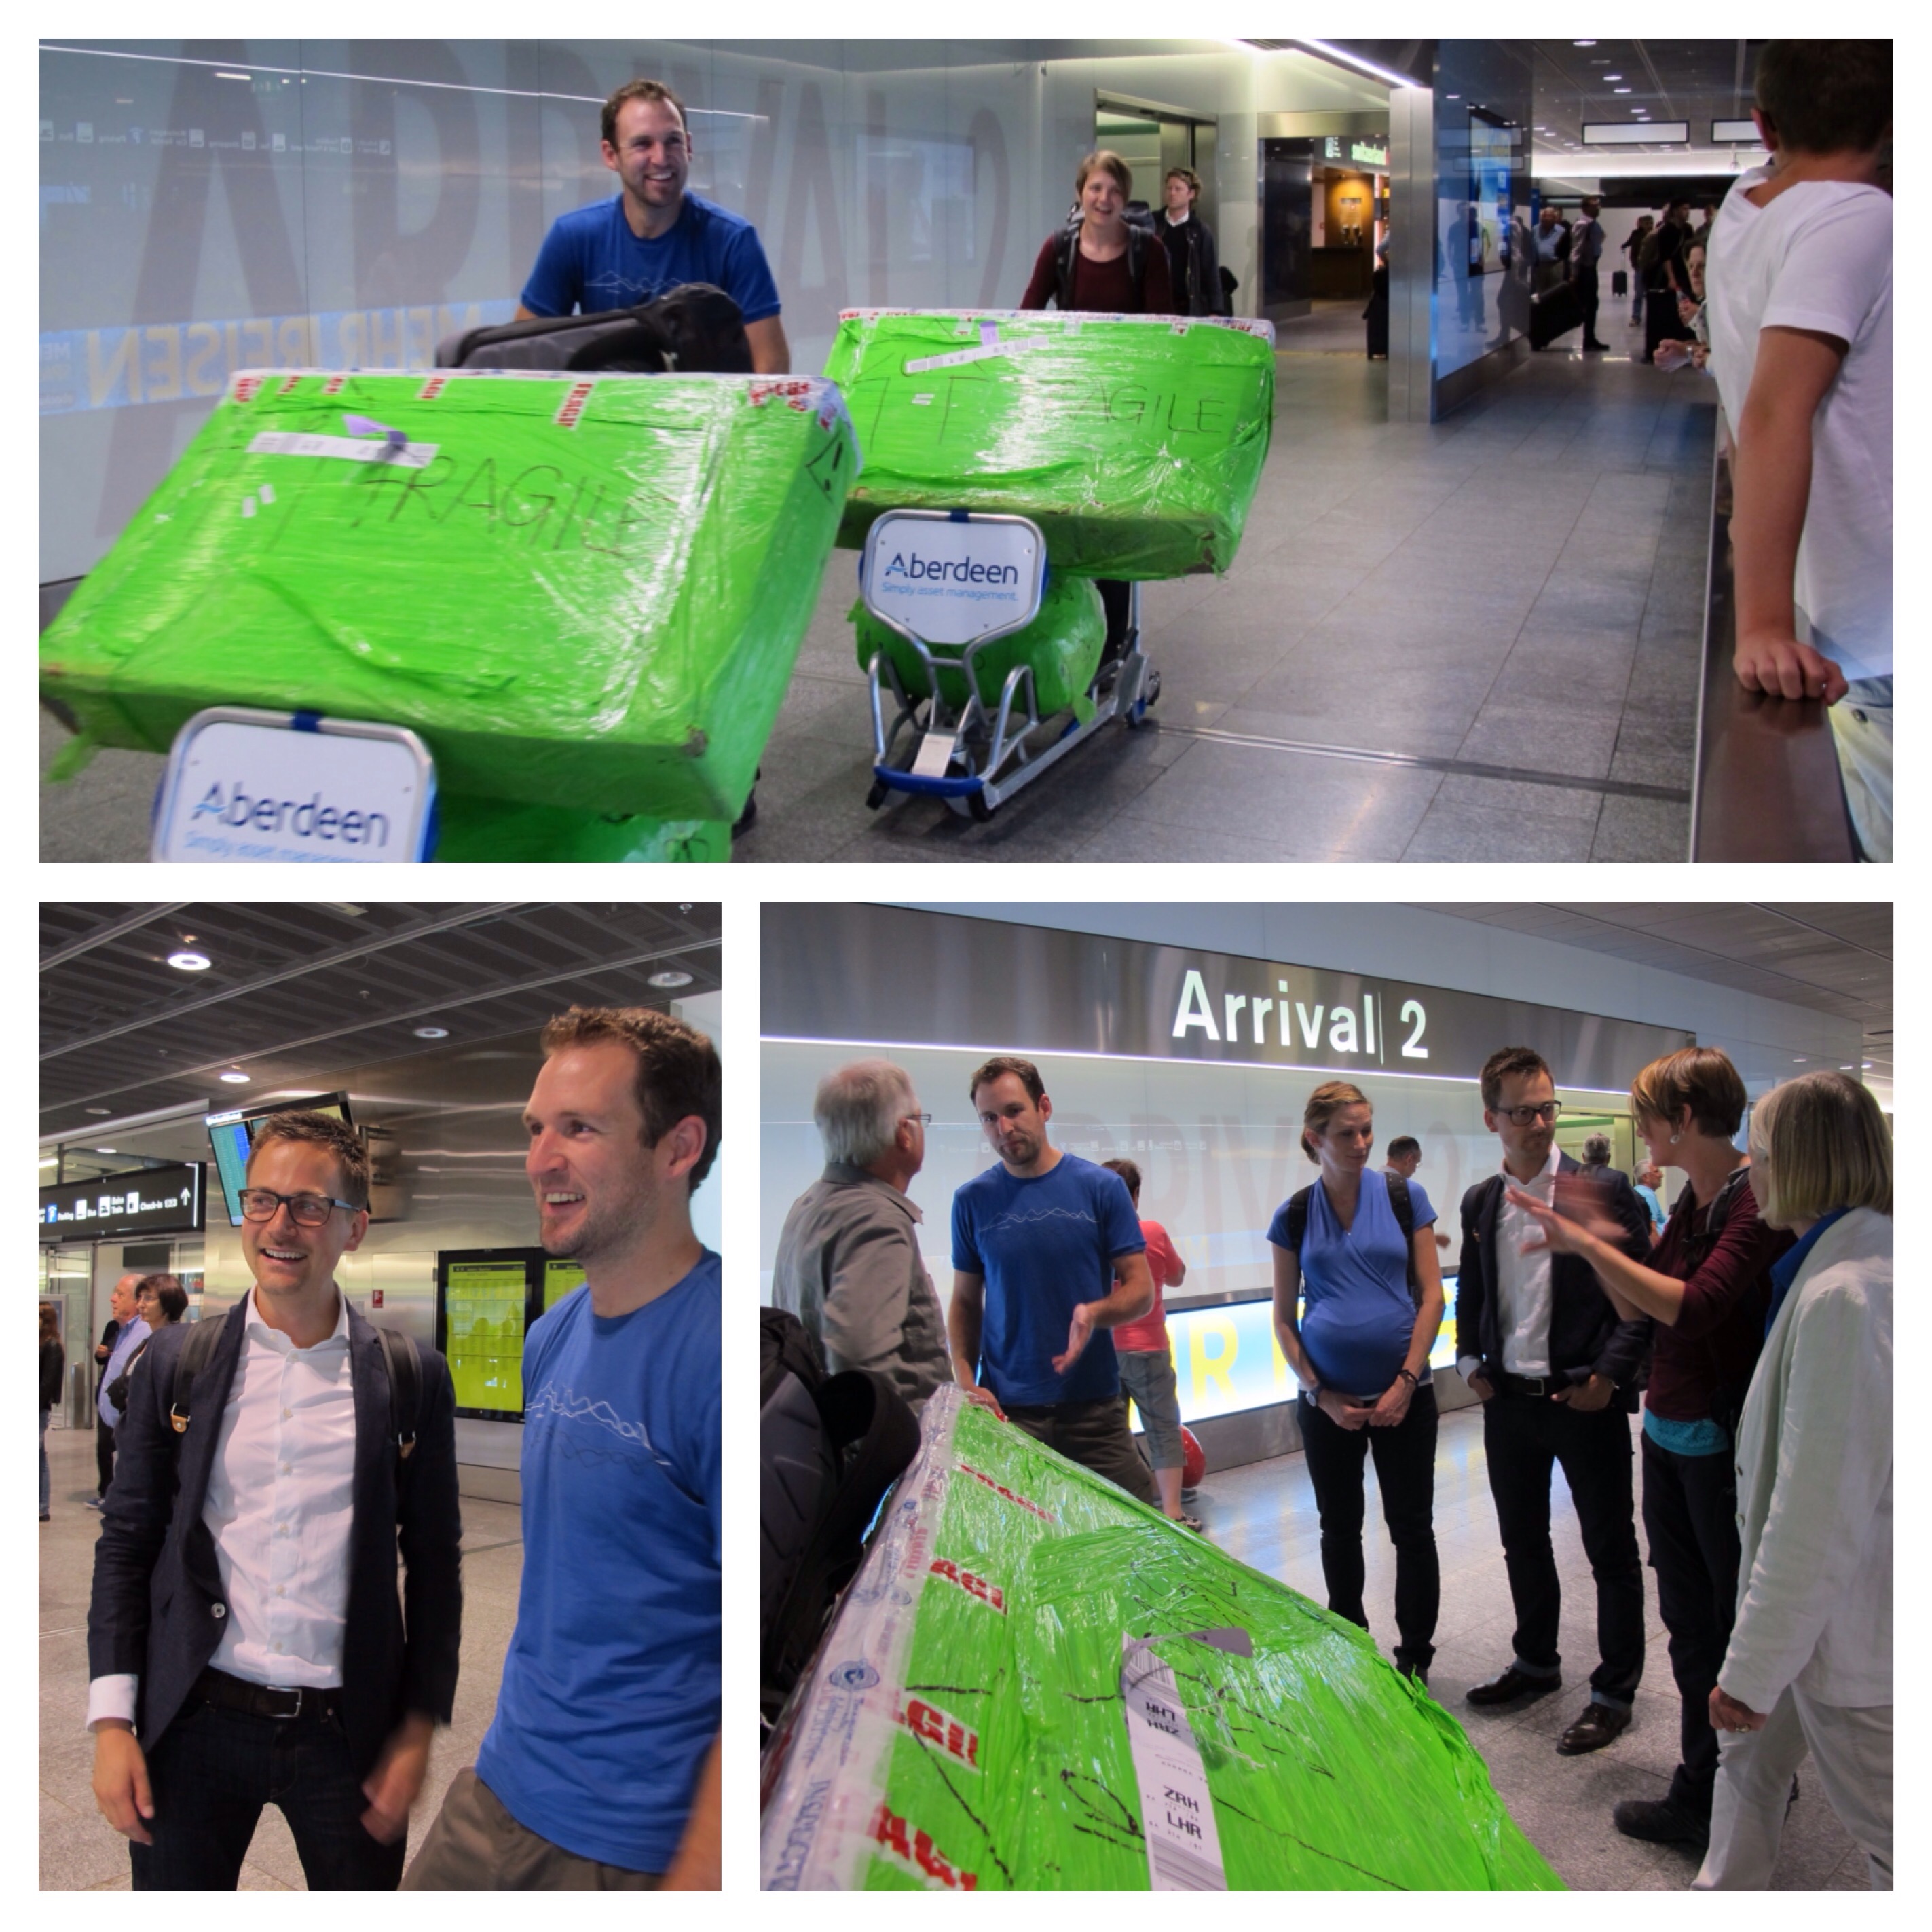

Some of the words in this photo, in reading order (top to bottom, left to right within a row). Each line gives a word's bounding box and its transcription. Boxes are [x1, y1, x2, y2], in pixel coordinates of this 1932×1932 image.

[1037, 377, 1225, 434] AGILE
[885, 553, 1018, 585] Aberdeen
[882, 582, 915, 596] Simply
[917, 585, 944, 597] asset
[191, 781, 390, 848] Aberdeen
[1172, 969, 1375, 1054] Arrival
[1400, 999, 1429, 1059] 2
[1146, 1701, 1176, 1722] LHR
[1147, 1718, 1182, 1738] ZRH
[1163, 1785, 1200, 1813] ZRH
[1166, 1810, 1202, 1840] LHR
